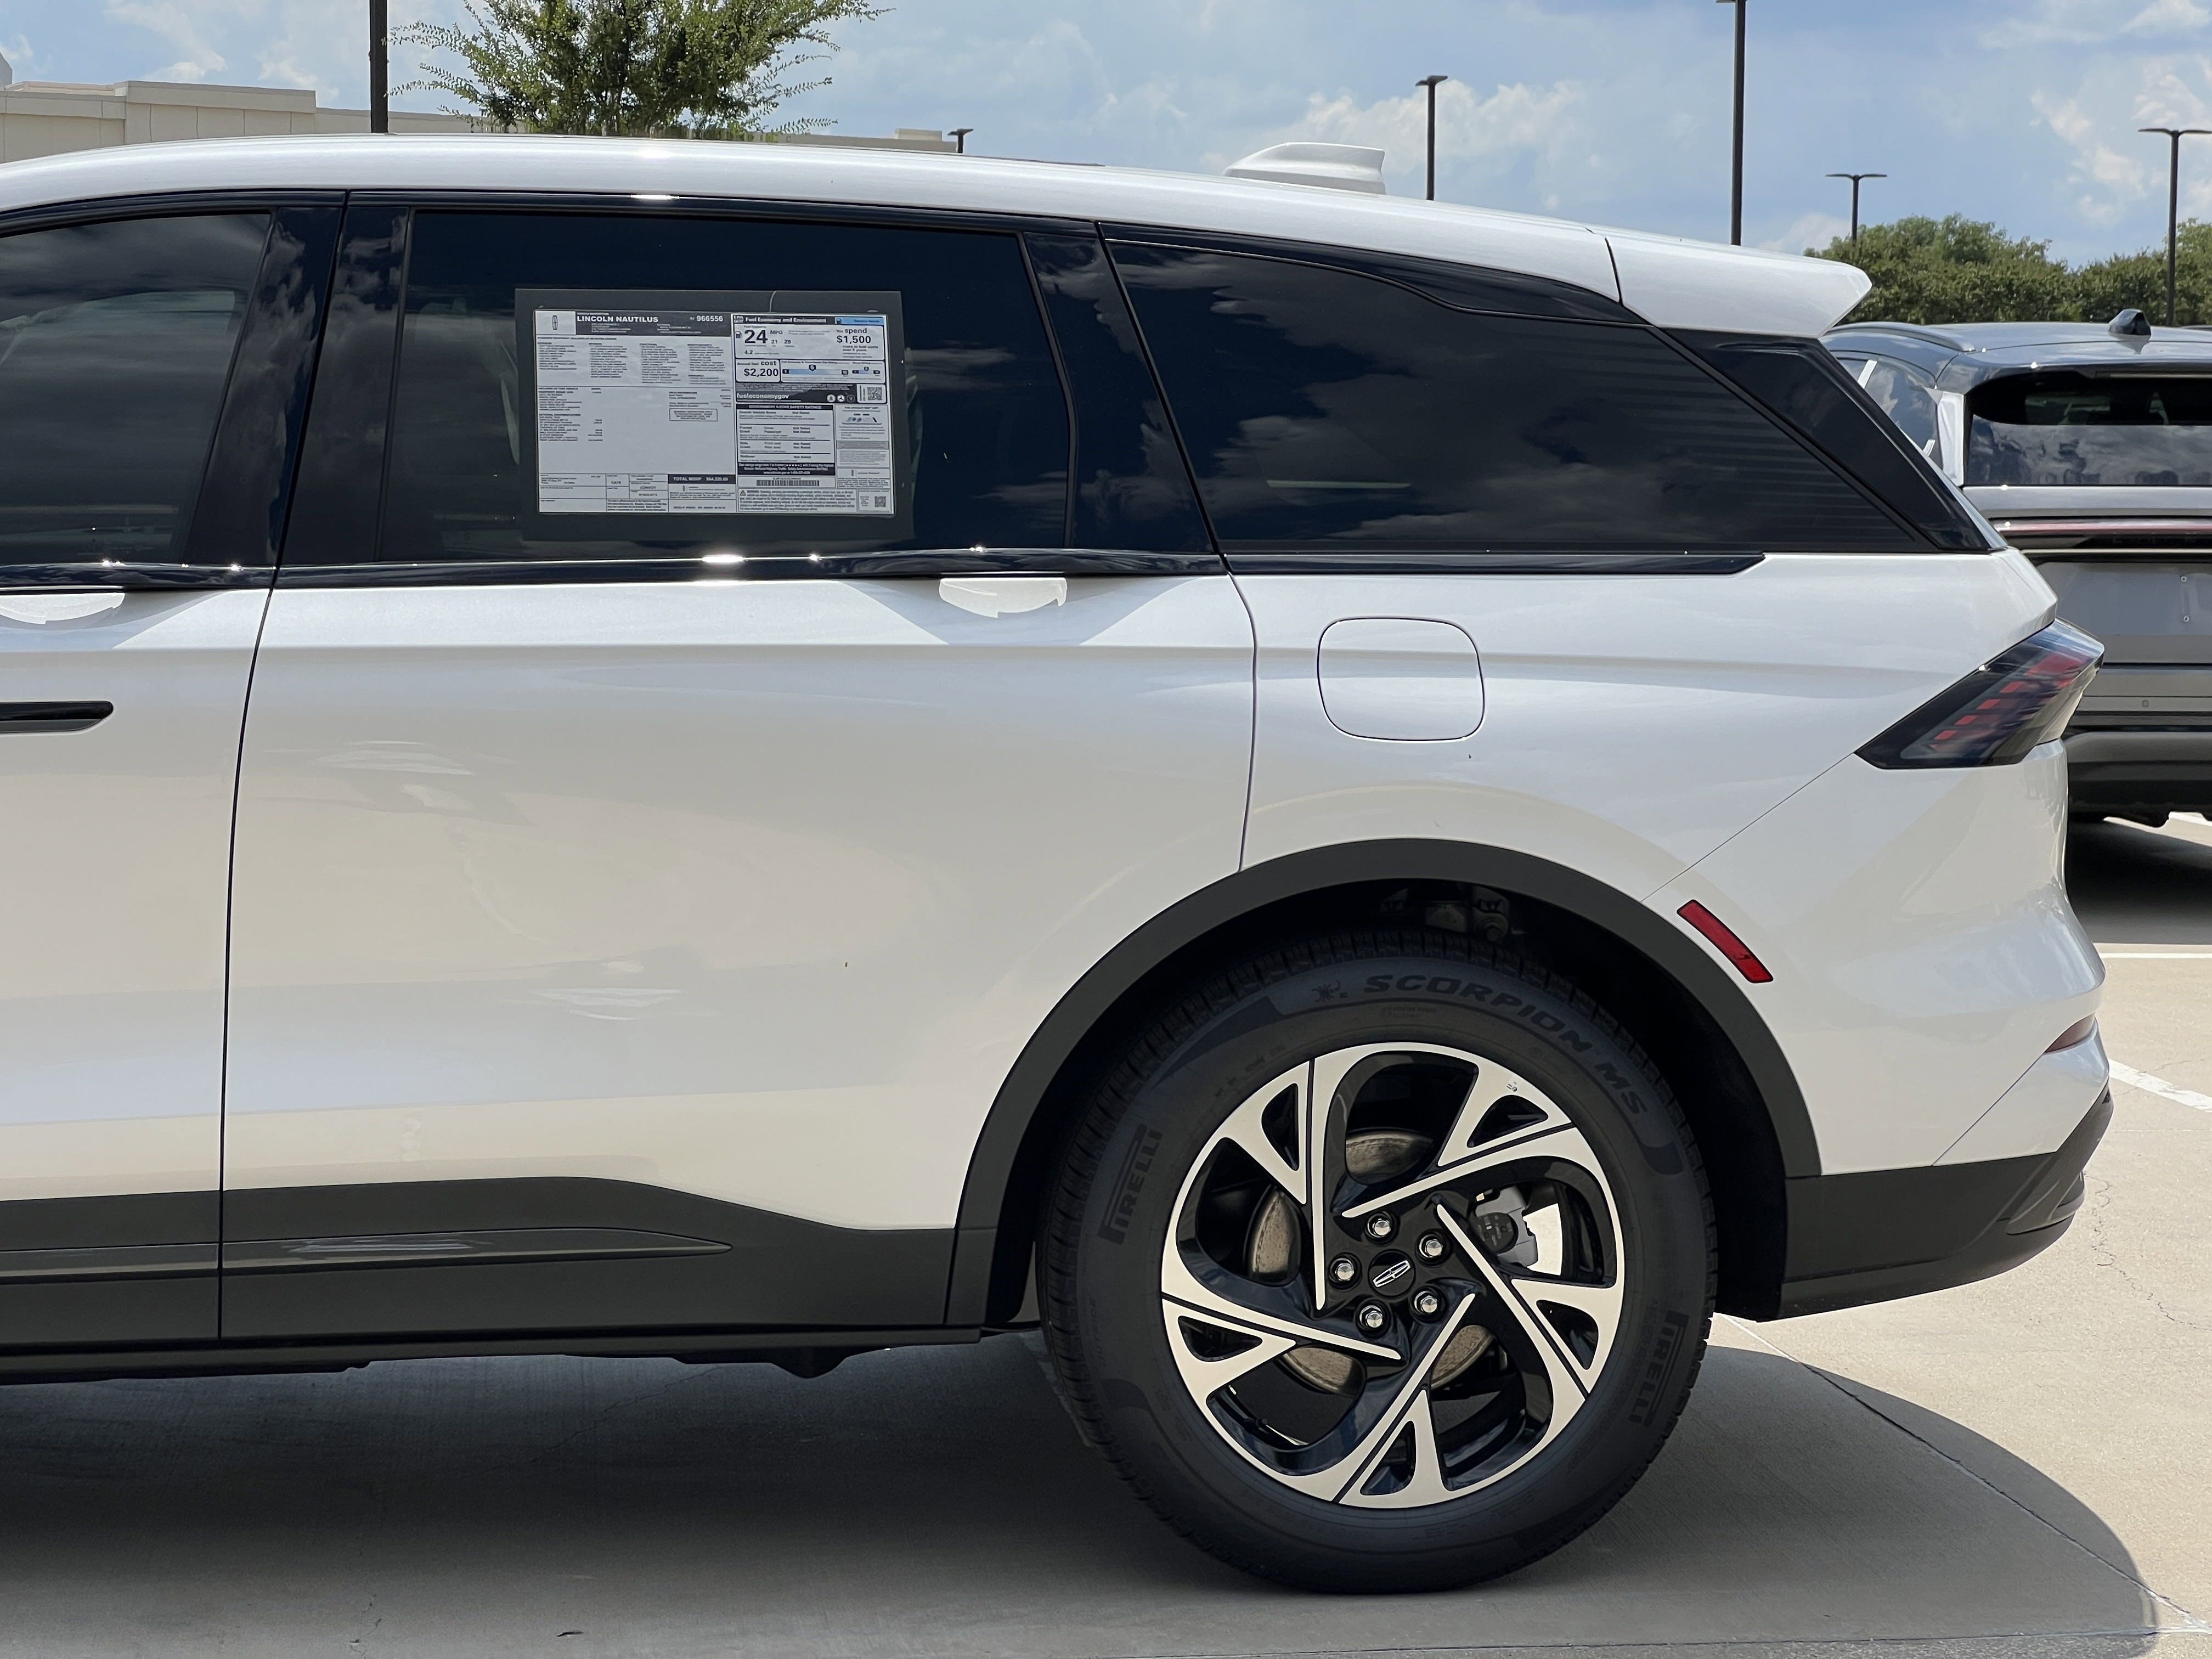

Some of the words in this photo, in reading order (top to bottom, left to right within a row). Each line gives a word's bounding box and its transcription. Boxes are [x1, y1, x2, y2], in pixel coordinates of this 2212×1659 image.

[744, 330, 768, 343] 24
[837, 335, 871, 344] $1,500
[744, 368, 778, 377] $2,200
[1364, 974, 1593, 1052] SCORPION
[1594, 1062, 1647, 1115] MS
[1097, 1124, 1163, 1244] PIRELLI
[1628, 1309, 1690, 1427] PIRELLI
